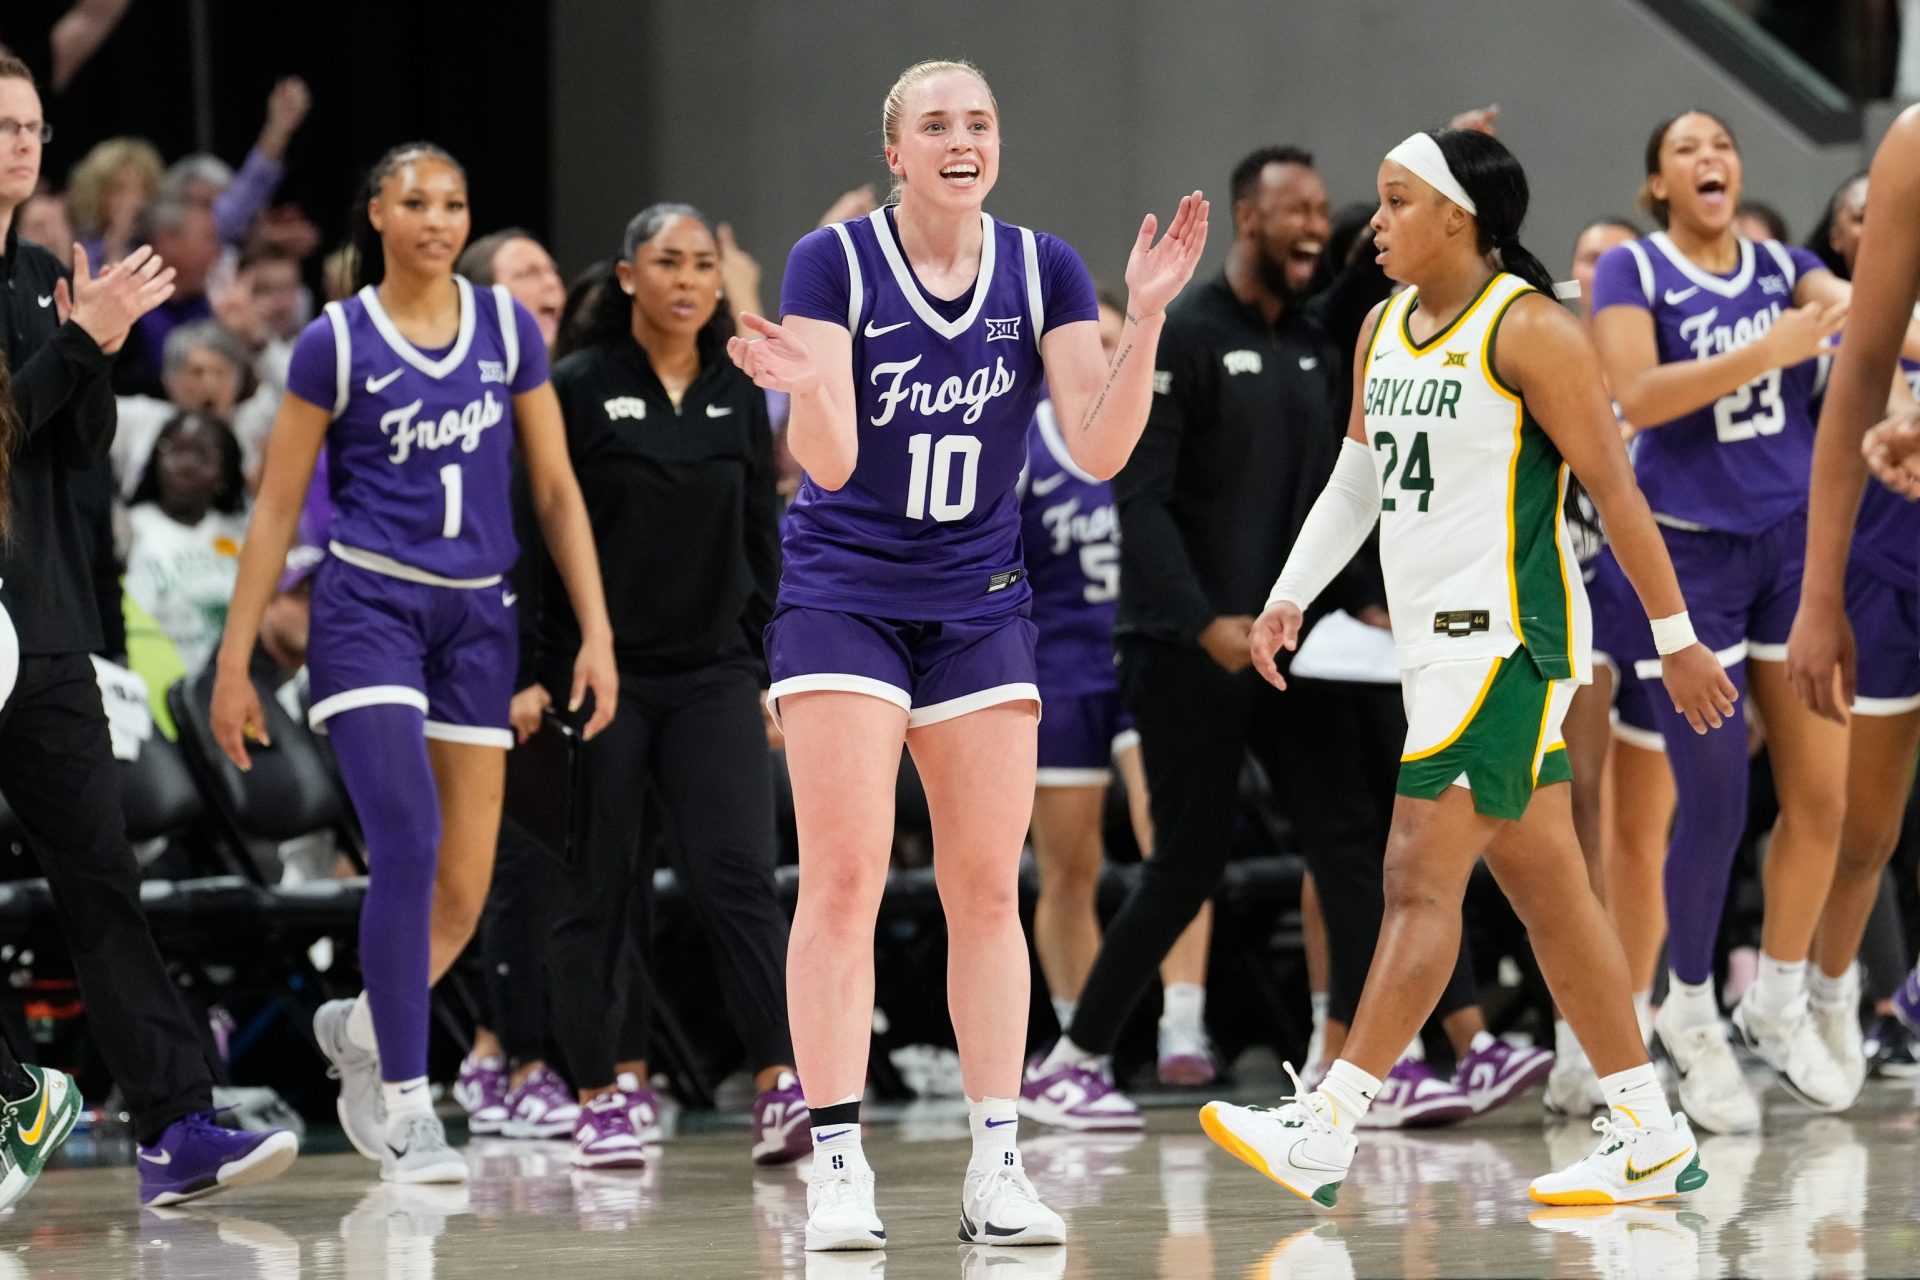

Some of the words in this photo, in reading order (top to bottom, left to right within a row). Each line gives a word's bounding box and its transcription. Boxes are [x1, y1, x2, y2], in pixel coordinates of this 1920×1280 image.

[380, 390, 503, 465] Frogs
[870, 354, 1016, 427] Frogs
[1365, 378, 1462, 419] BAYLOR
[1714, 368, 1786, 443] 23
[440, 463, 463, 538] 1
[906, 433, 982, 522] 10
[1374, 431, 1434, 512] 24
[1079, 542, 1120, 604] 5
